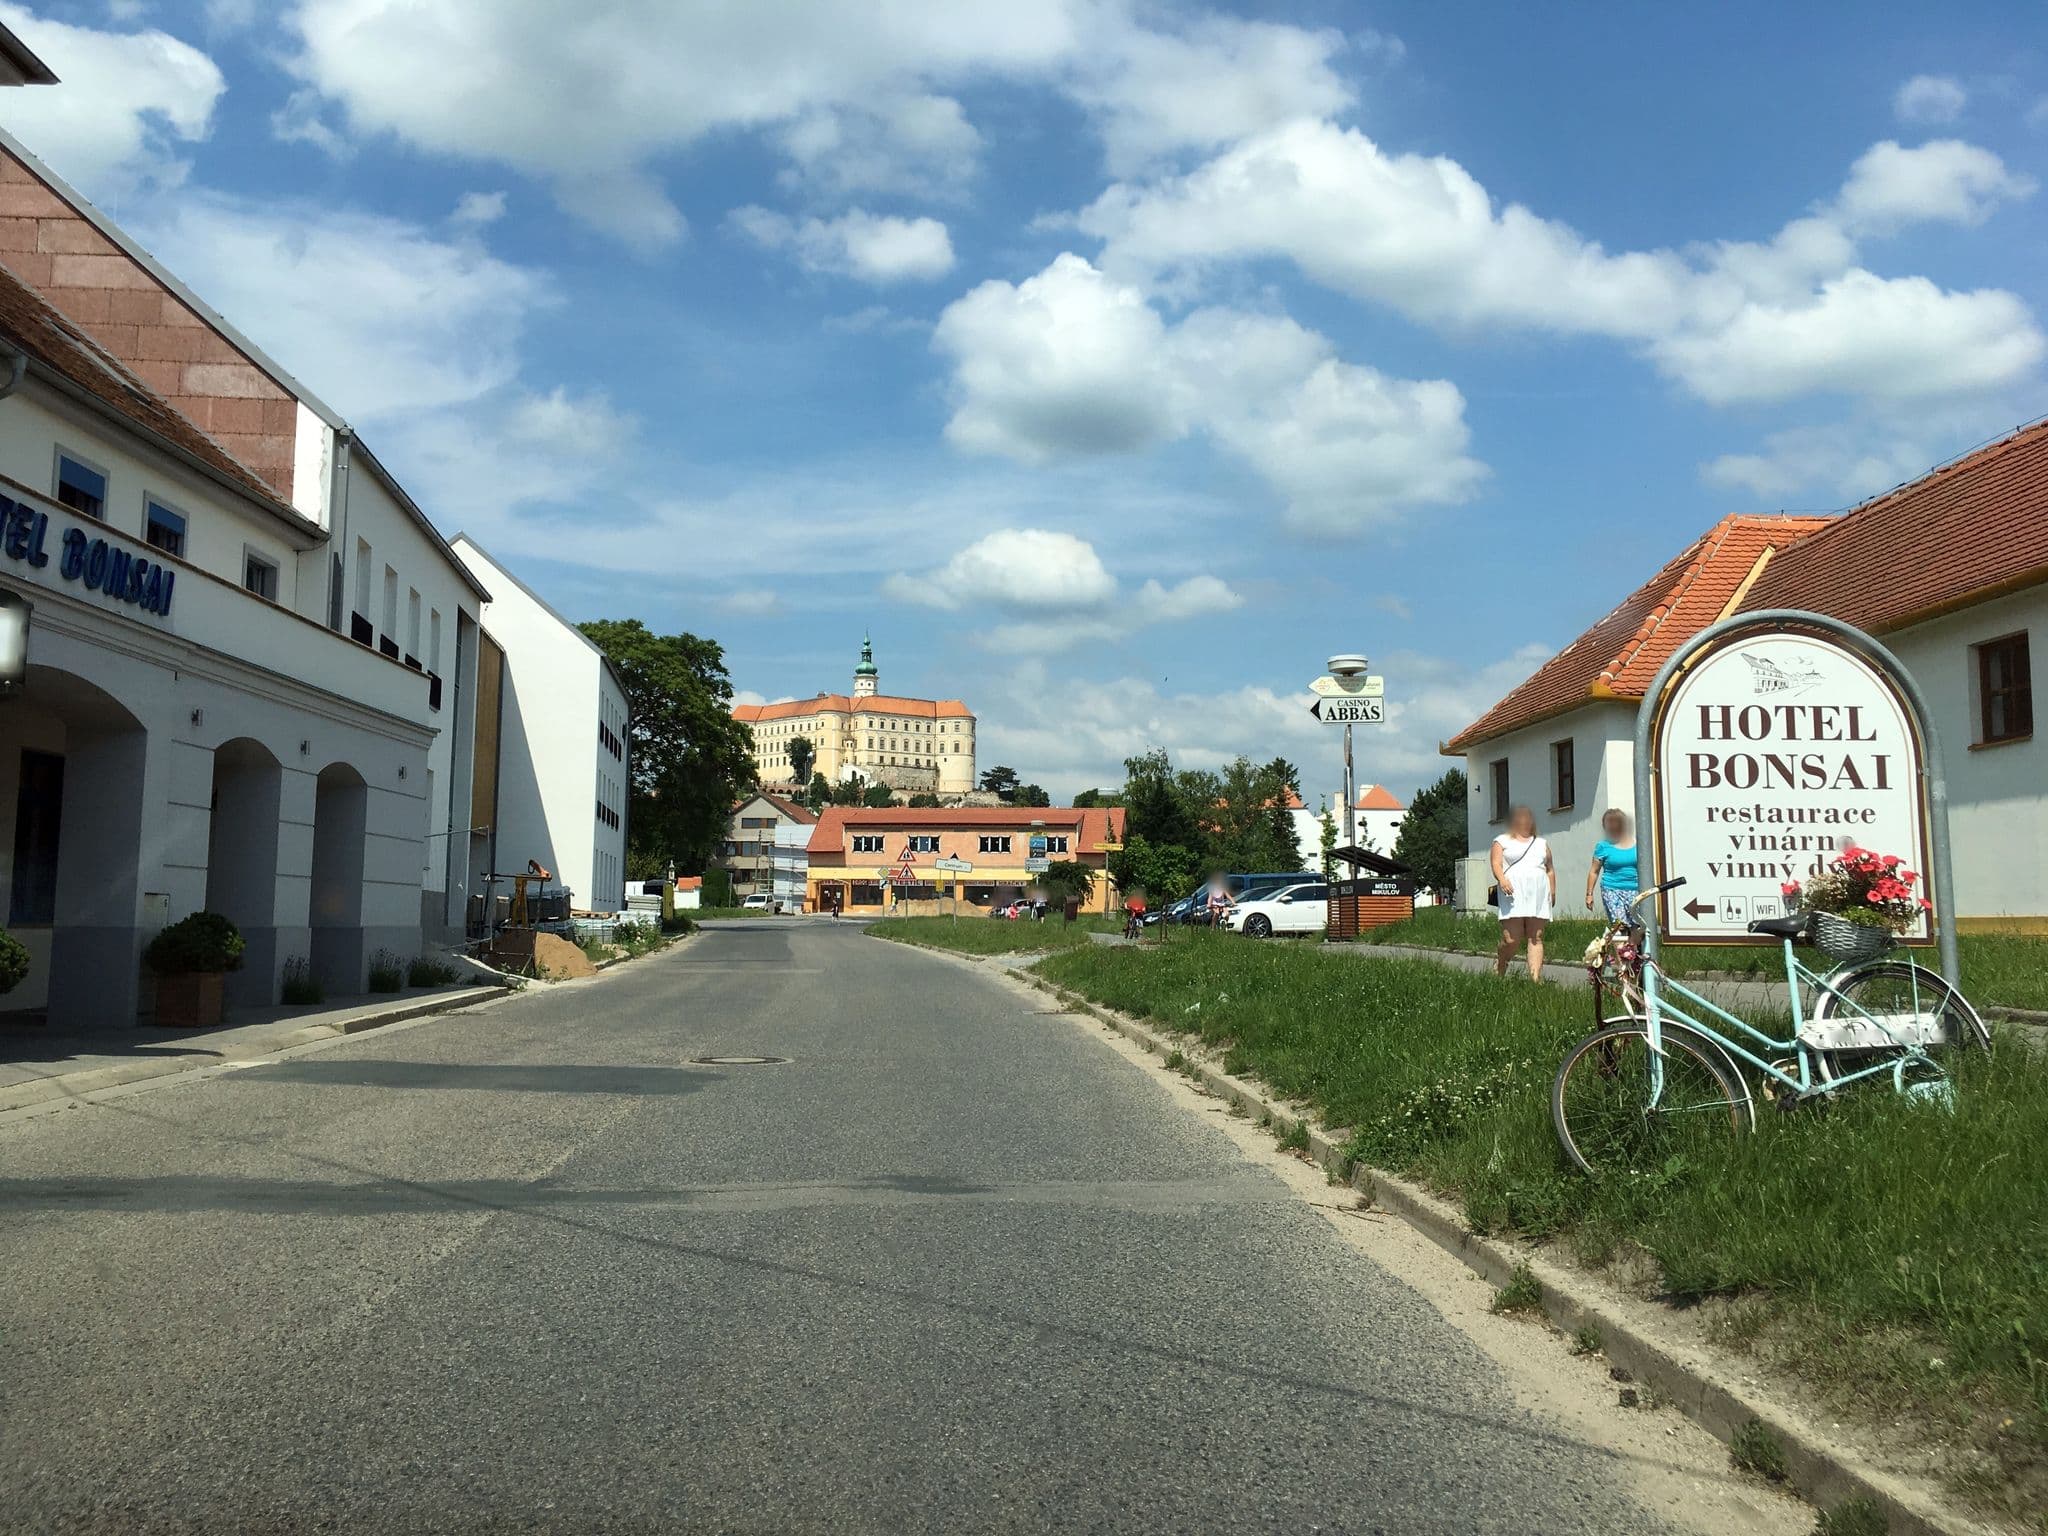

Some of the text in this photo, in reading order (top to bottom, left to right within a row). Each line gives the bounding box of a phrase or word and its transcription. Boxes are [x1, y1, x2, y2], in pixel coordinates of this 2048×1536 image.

[60, 527, 175, 617] BONSAI
[1325, 706, 1380, 721] ABBAS
[1337, 699, 1370, 707] CASINO
[1696, 704, 1877, 741] HOTEL
[1686, 753, 1893, 790] BONSAI
[1706, 804, 1876, 824] restaurace
[1707, 854, 1797, 882] vinný
[1757, 904, 1776, 915] WIFI
